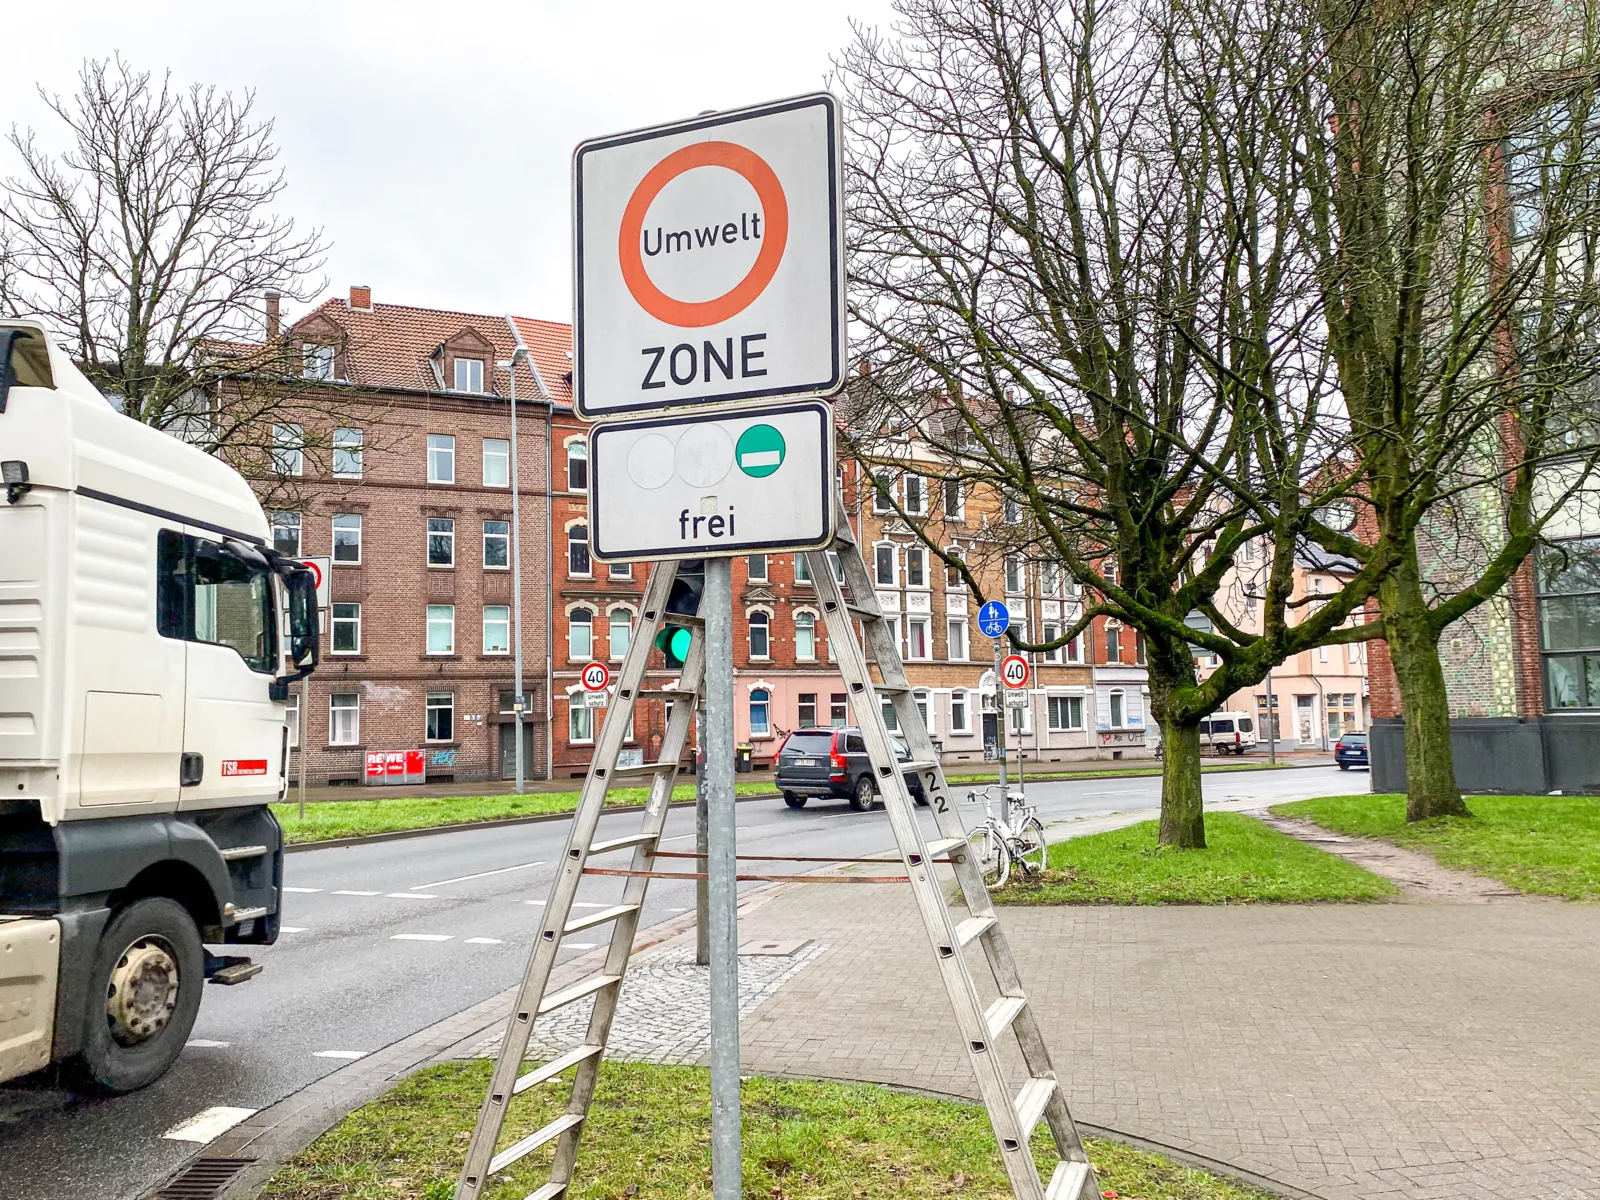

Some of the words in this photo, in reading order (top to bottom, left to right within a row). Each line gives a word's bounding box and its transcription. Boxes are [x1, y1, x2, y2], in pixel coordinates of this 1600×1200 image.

[643, 212, 761, 256] Umwelt
[641, 333, 768, 390] ZONE
[678, 505, 735, 540] frei
[587, 670, 604, 684] 40
[1007, 664, 1024, 680] 40
[222, 761, 238, 776] TSR
[925, 771, 941, 792] 2
[934, 796, 949, 814] 2
